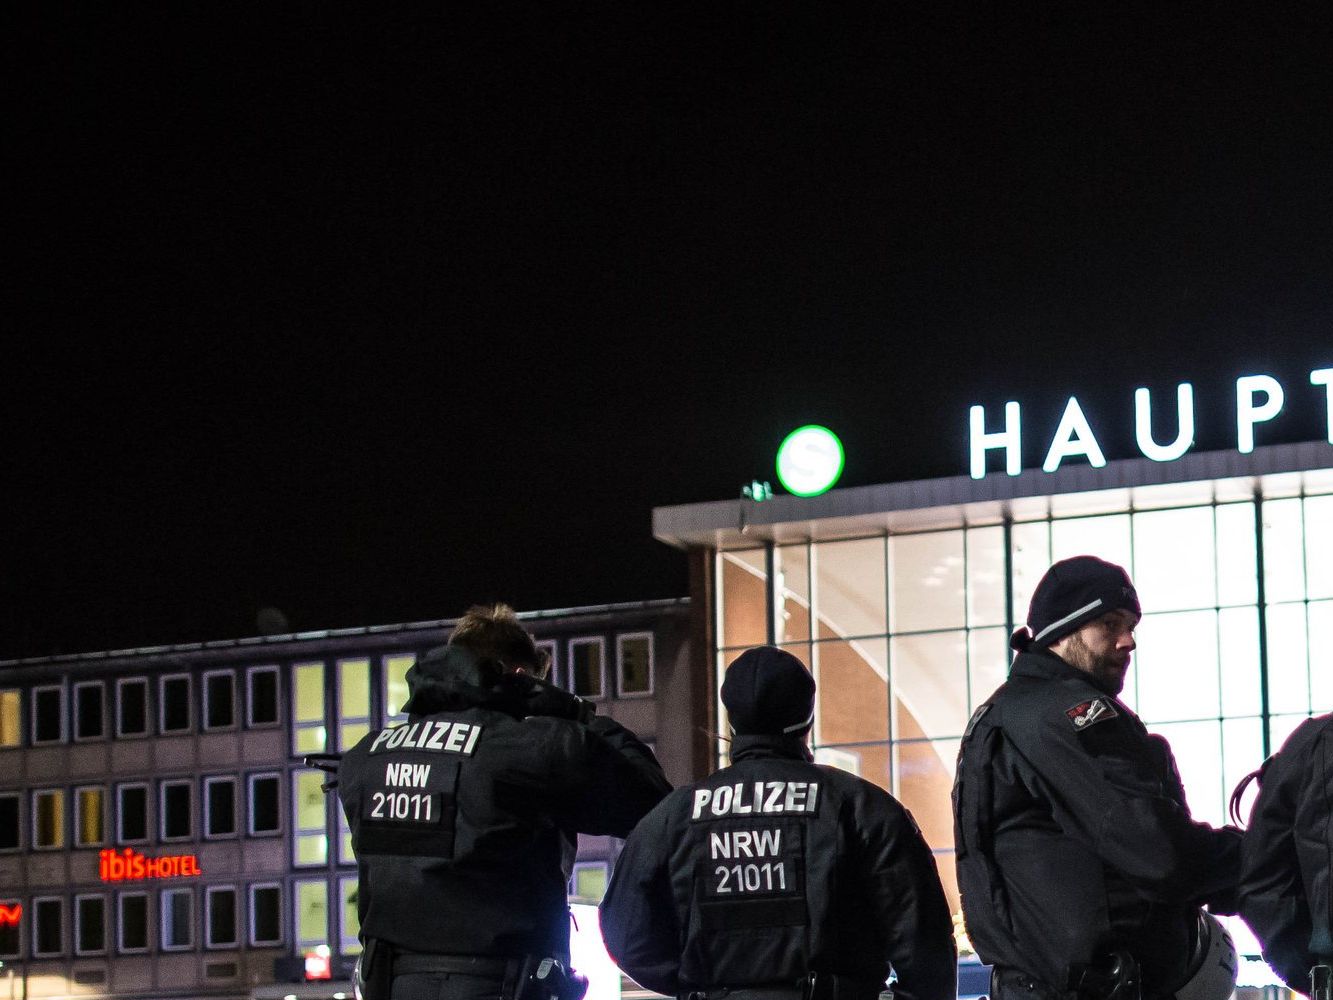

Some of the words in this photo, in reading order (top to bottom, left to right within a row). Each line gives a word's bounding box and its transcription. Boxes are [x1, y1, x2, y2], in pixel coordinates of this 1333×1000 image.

[369, 720, 481, 753] POLIZEI
[385, 762, 431, 789] NRW
[370, 791, 432, 821] 21011
[691, 780, 819, 820] POLIZEI
[710, 828, 781, 860] NRW
[99, 848, 145, 881] ibis
[146, 855, 201, 878] HOTEL
[715, 862, 786, 893] 21011
